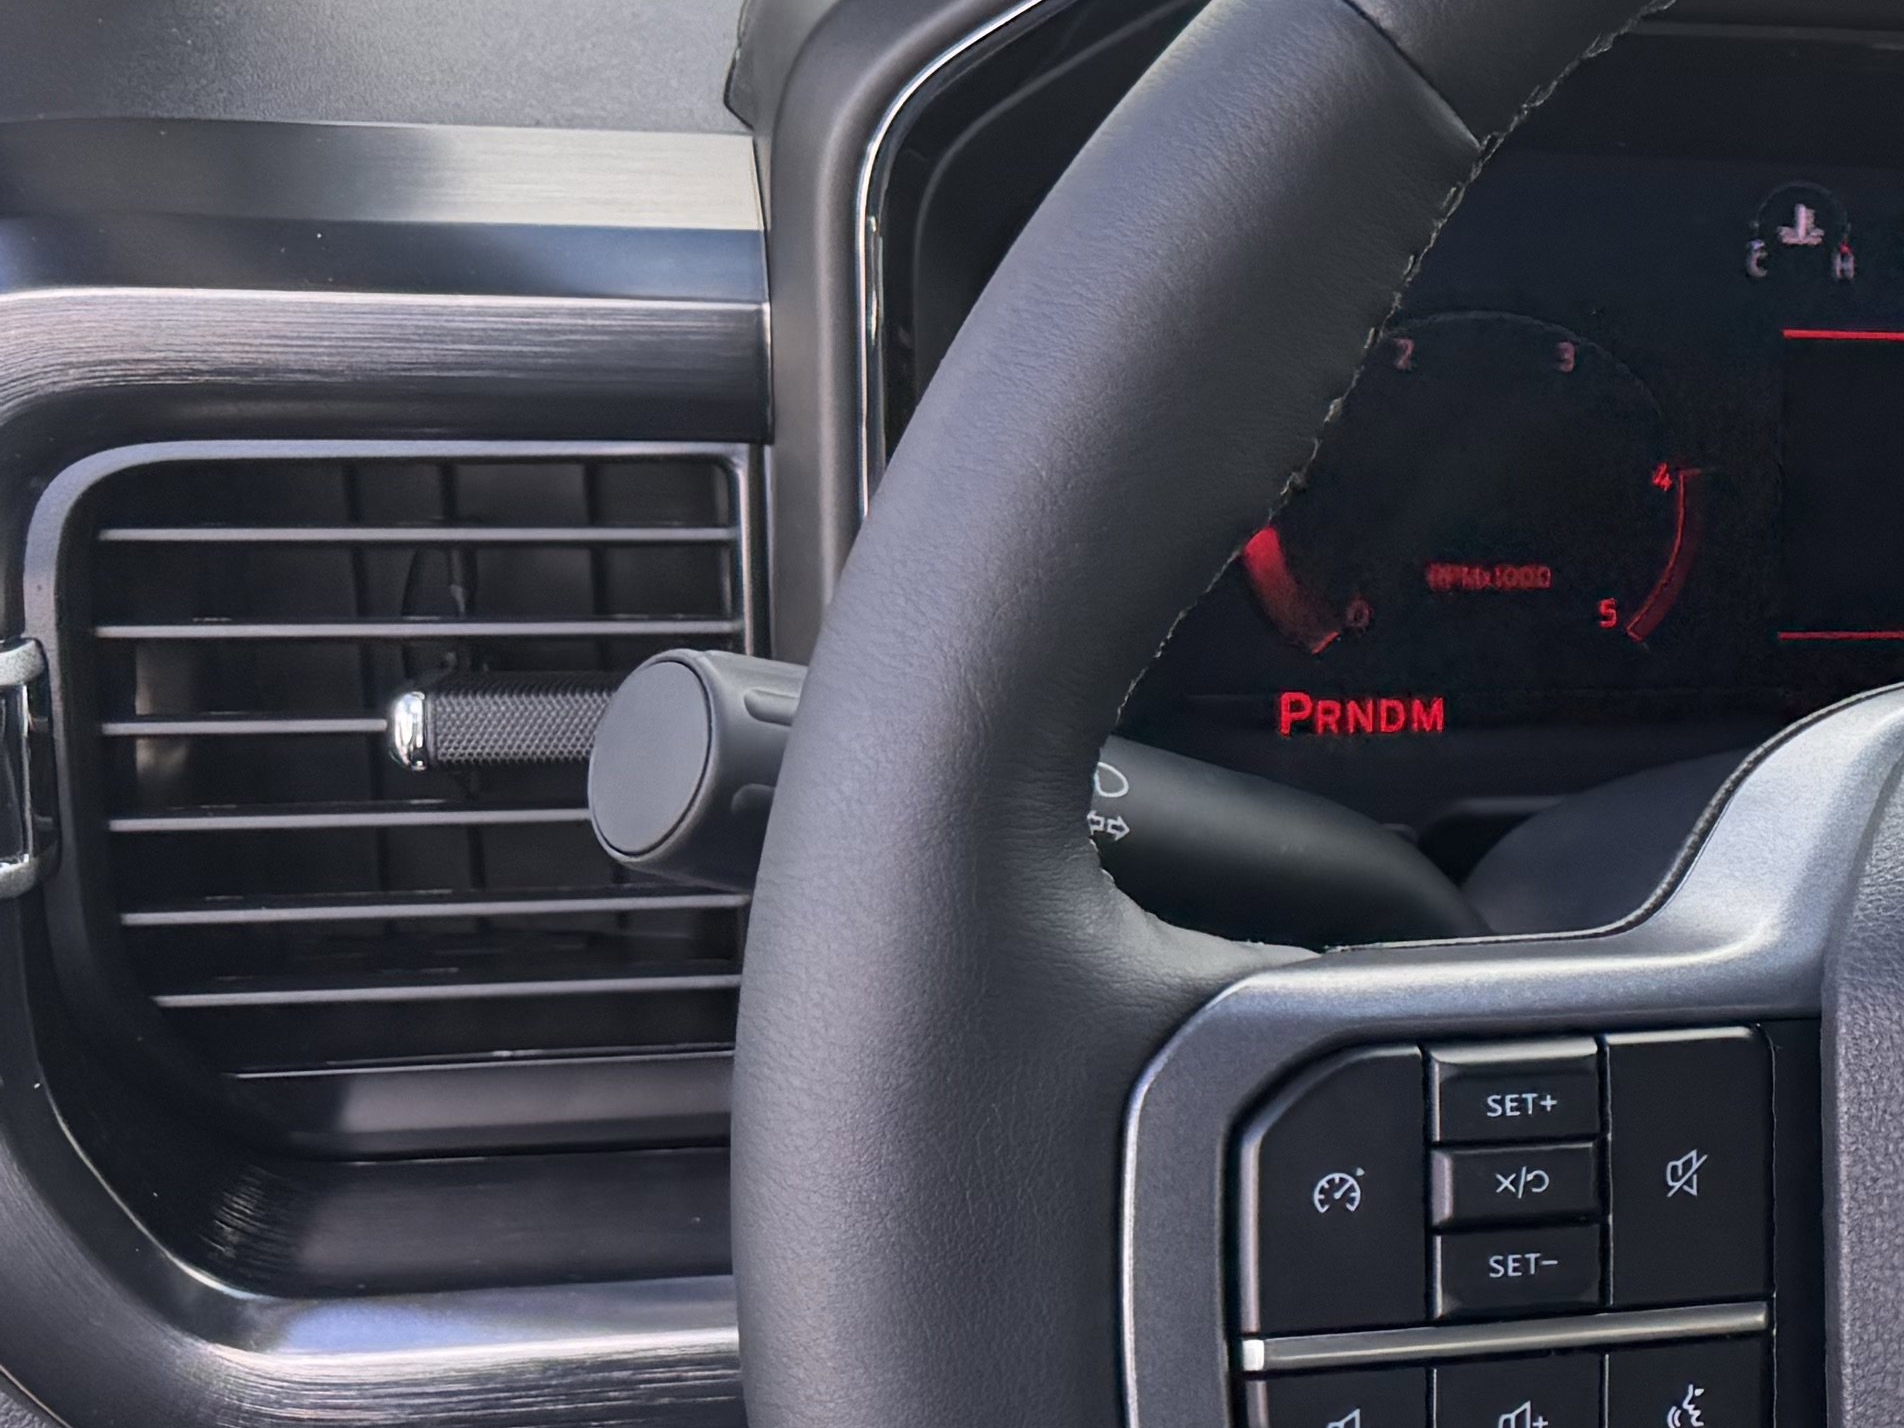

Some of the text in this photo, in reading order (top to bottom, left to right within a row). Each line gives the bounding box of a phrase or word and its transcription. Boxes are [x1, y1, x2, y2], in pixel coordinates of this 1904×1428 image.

[1652, 462, 1672, 490] 4
[1598, 598, 1617, 627] 5
[1486, 1092, 1558, 1118] SET+
